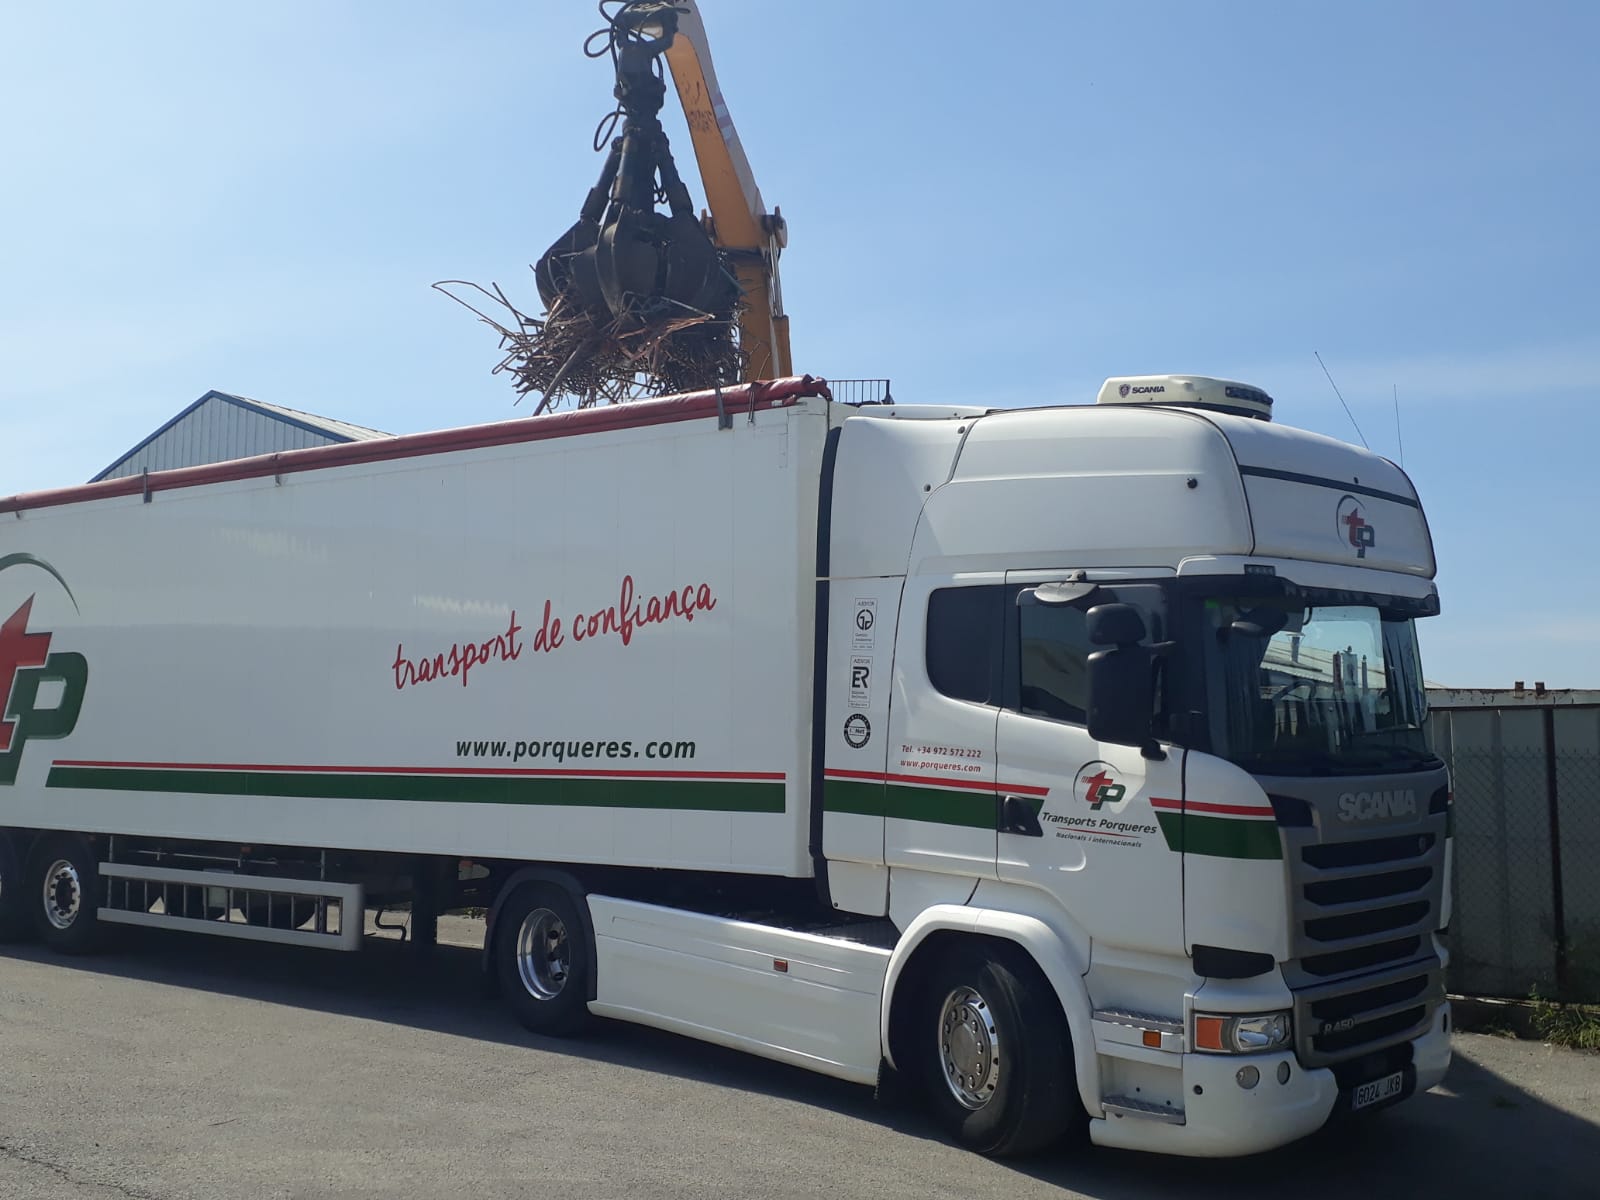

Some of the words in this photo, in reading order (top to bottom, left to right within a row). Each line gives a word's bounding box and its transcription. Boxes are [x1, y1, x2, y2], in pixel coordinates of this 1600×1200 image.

[1132, 386, 1165, 394] SCANIA
[392, 610, 522, 689] transport
[534, 600, 564, 652] de
[572, 575, 717, 645] confiança
[456, 740, 696, 762] www.porqueres.com
[902, 745, 914, 753] Tel.
[917, 746, 931, 754] +34
[933, 747, 948, 756] 972
[950, 749, 965, 758] 572
[967, 750, 981, 758] 222
[900, 760, 981, 773] www.porqueres.com
[1338, 790, 1416, 822] SCANIA
[1042, 812, 1097, 827] Transports
[1100, 819, 1157, 834] Porqueres
[1056, 832, 1086, 841] Nacionals
[1092, 836, 1142, 848] internacionals
[1333, 1018, 1354, 1032] 450
[1358, 1082, 1380, 1105] 6024
[1384, 1075, 1401, 1096] JKB
